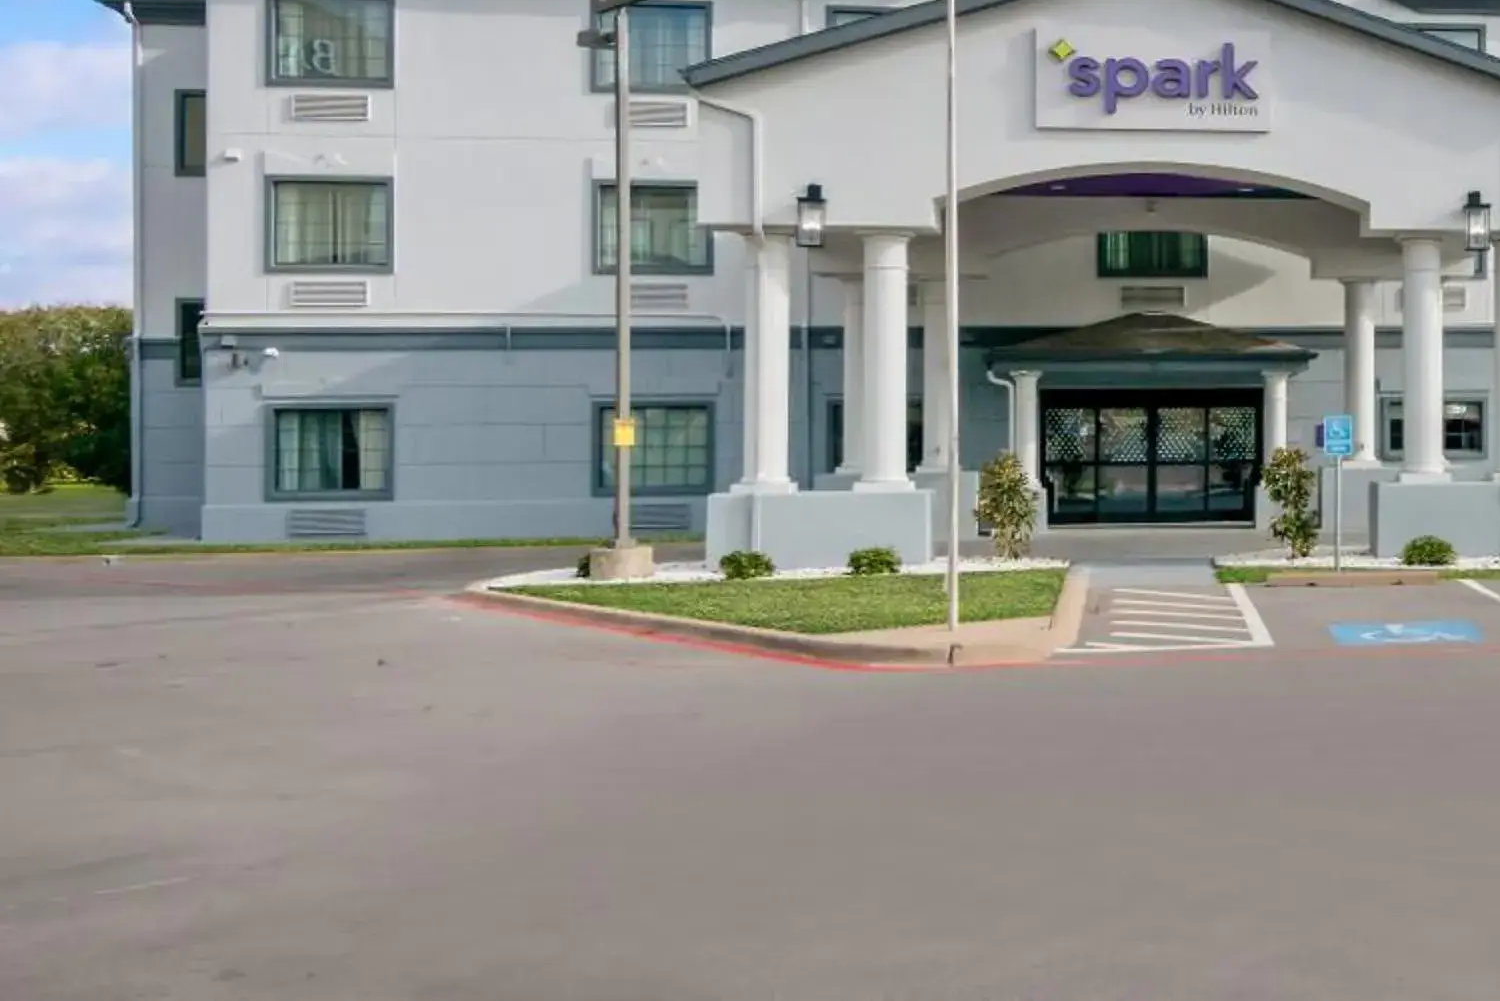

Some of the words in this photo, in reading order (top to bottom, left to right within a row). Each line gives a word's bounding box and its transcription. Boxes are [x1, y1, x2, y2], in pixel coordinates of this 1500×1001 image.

[1069, 42, 1258, 114] spark
[1188, 102, 1207, 118] by
[1211, 102, 1259, 117] Hilton
